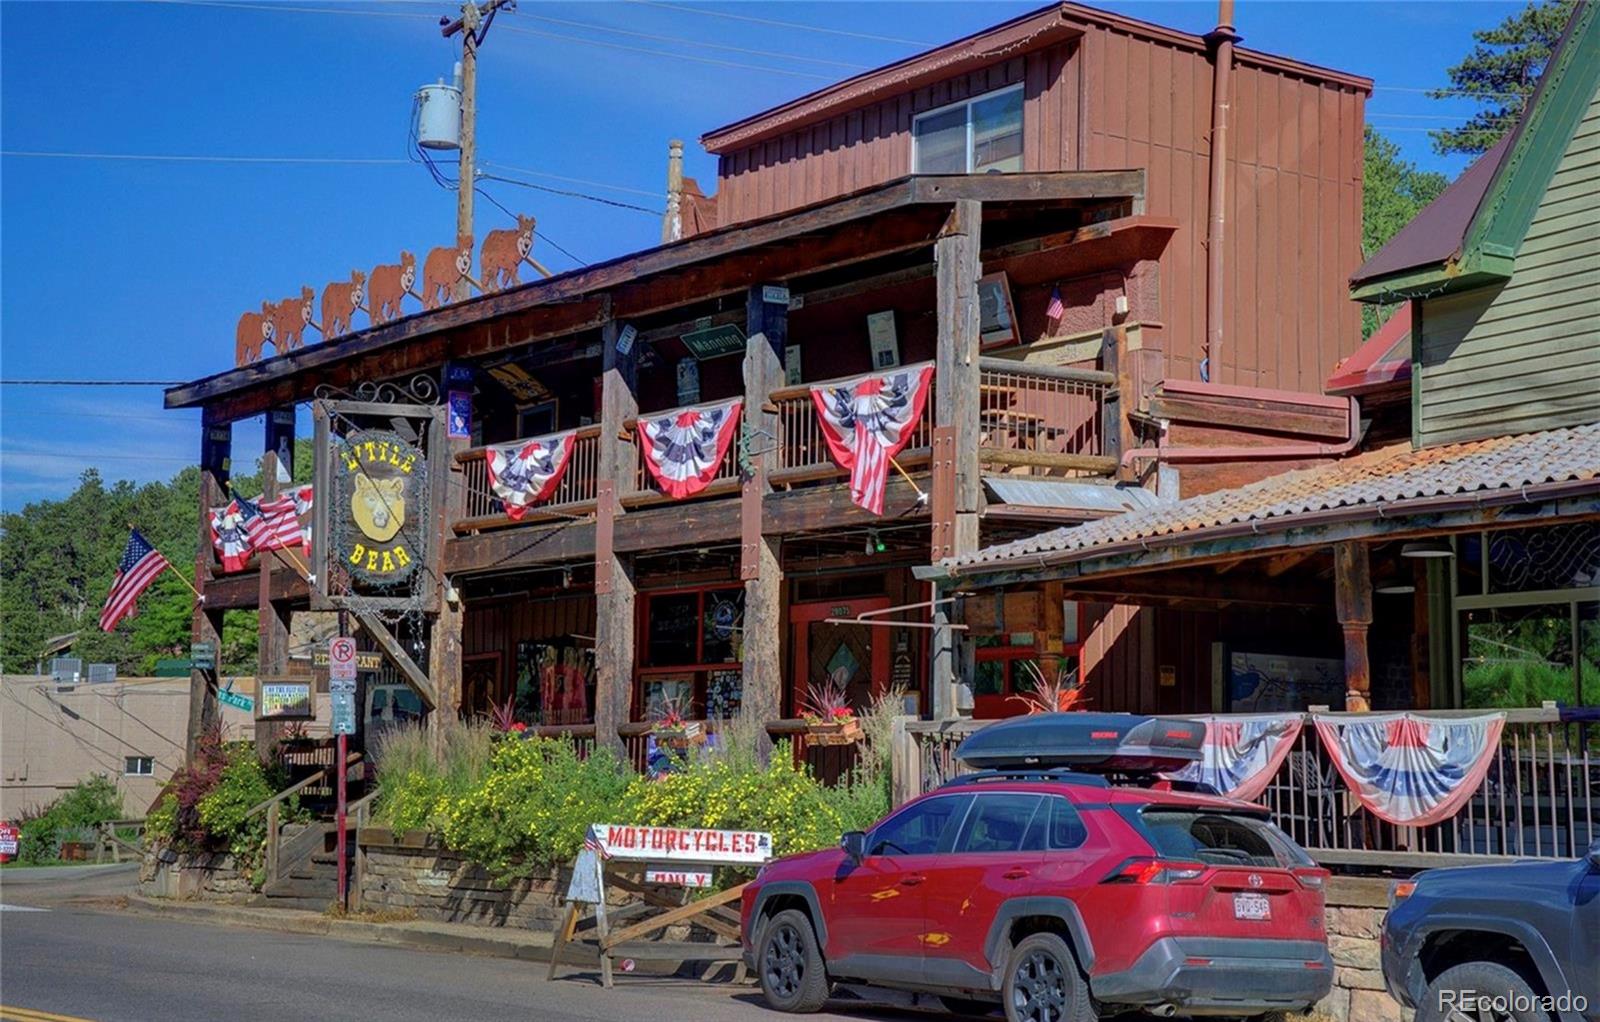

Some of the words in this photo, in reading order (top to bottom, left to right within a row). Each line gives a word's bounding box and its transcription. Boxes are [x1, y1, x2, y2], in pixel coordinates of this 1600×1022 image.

[340, 440, 416, 474] LITTLE
[349, 543, 411, 573] BEAR
[314, 653, 381, 669] RERANT
[607, 826, 757, 854] MOTORCYCLES
